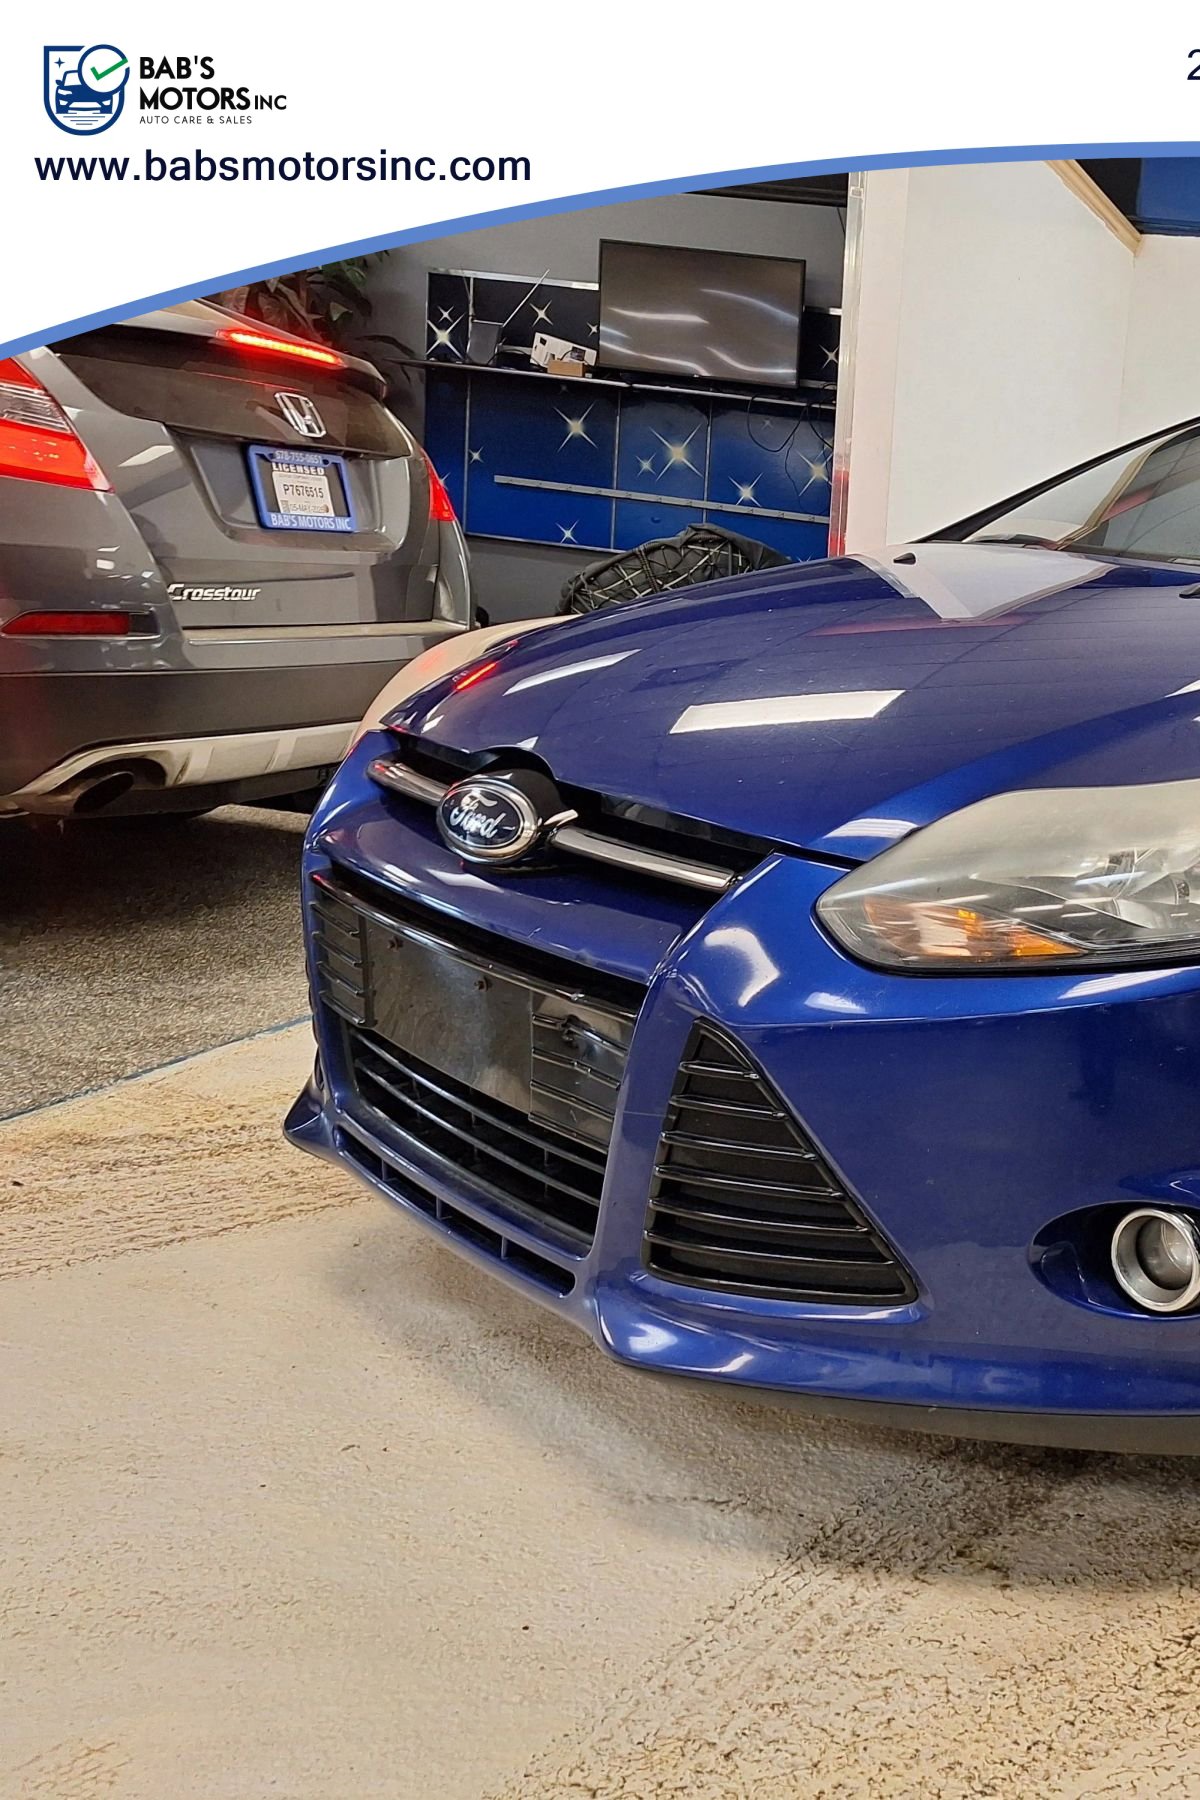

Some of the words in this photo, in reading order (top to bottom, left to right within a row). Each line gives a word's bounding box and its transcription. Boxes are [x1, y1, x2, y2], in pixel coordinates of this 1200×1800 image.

[272, 462, 325, 476] LICENSED
[283, 483, 324, 498] P7676515
[271, 513, 298, 527] BAB'S
[299, 516, 335, 529] MOTORS
[335, 517, 352, 530] INC
[167, 583, 262, 601] Crosstour
[449, 788, 507, 839] Ford
